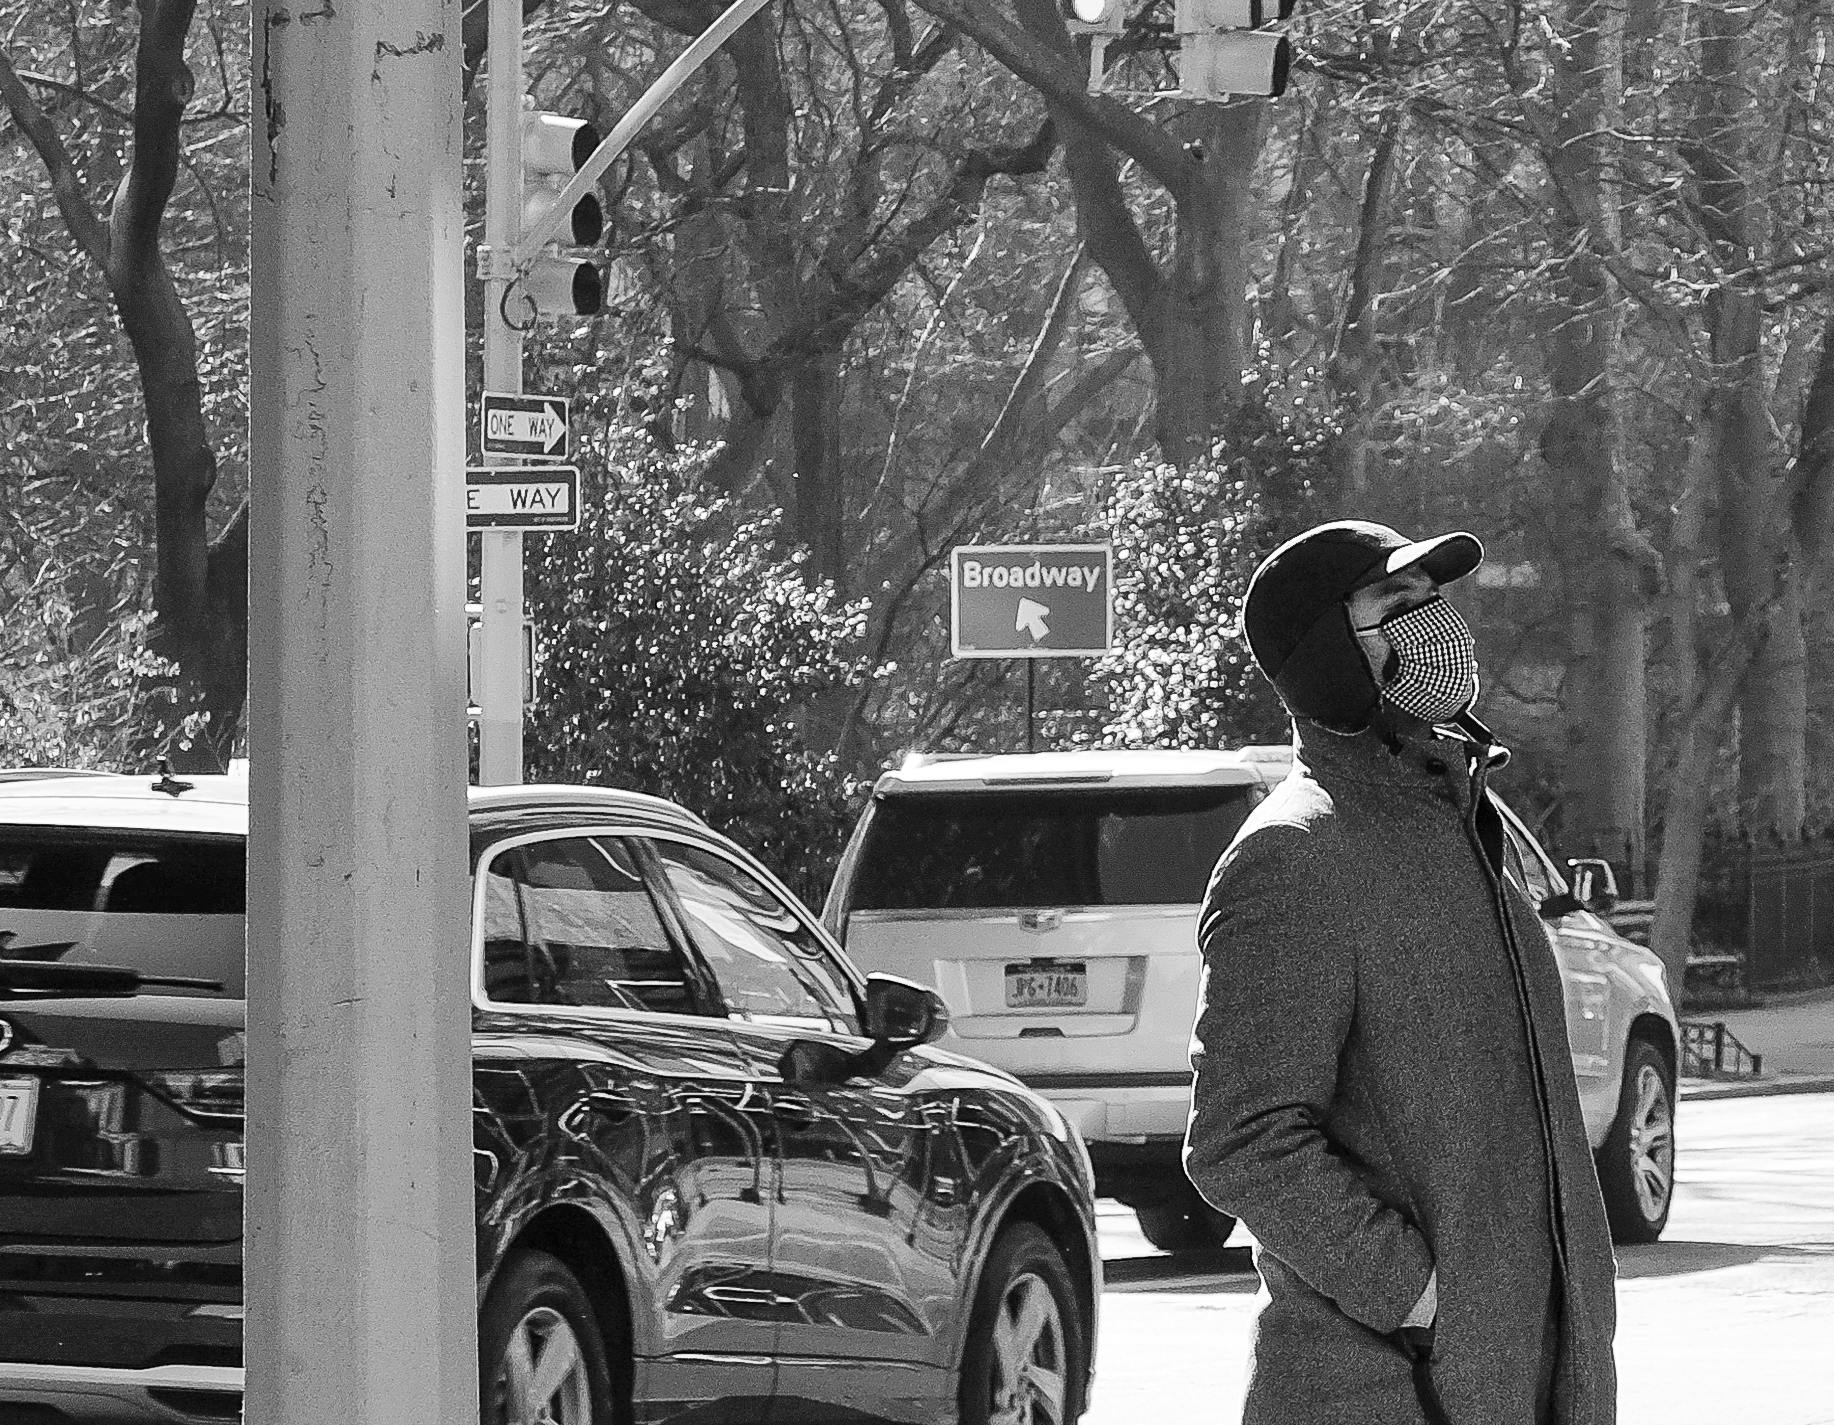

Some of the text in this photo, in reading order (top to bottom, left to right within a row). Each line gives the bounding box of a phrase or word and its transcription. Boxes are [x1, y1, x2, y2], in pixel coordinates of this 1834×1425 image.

[490, 414, 555, 439] ONE WAY
[509, 487, 561, 510] WAY
[962, 560, 1100, 593] Broadway
